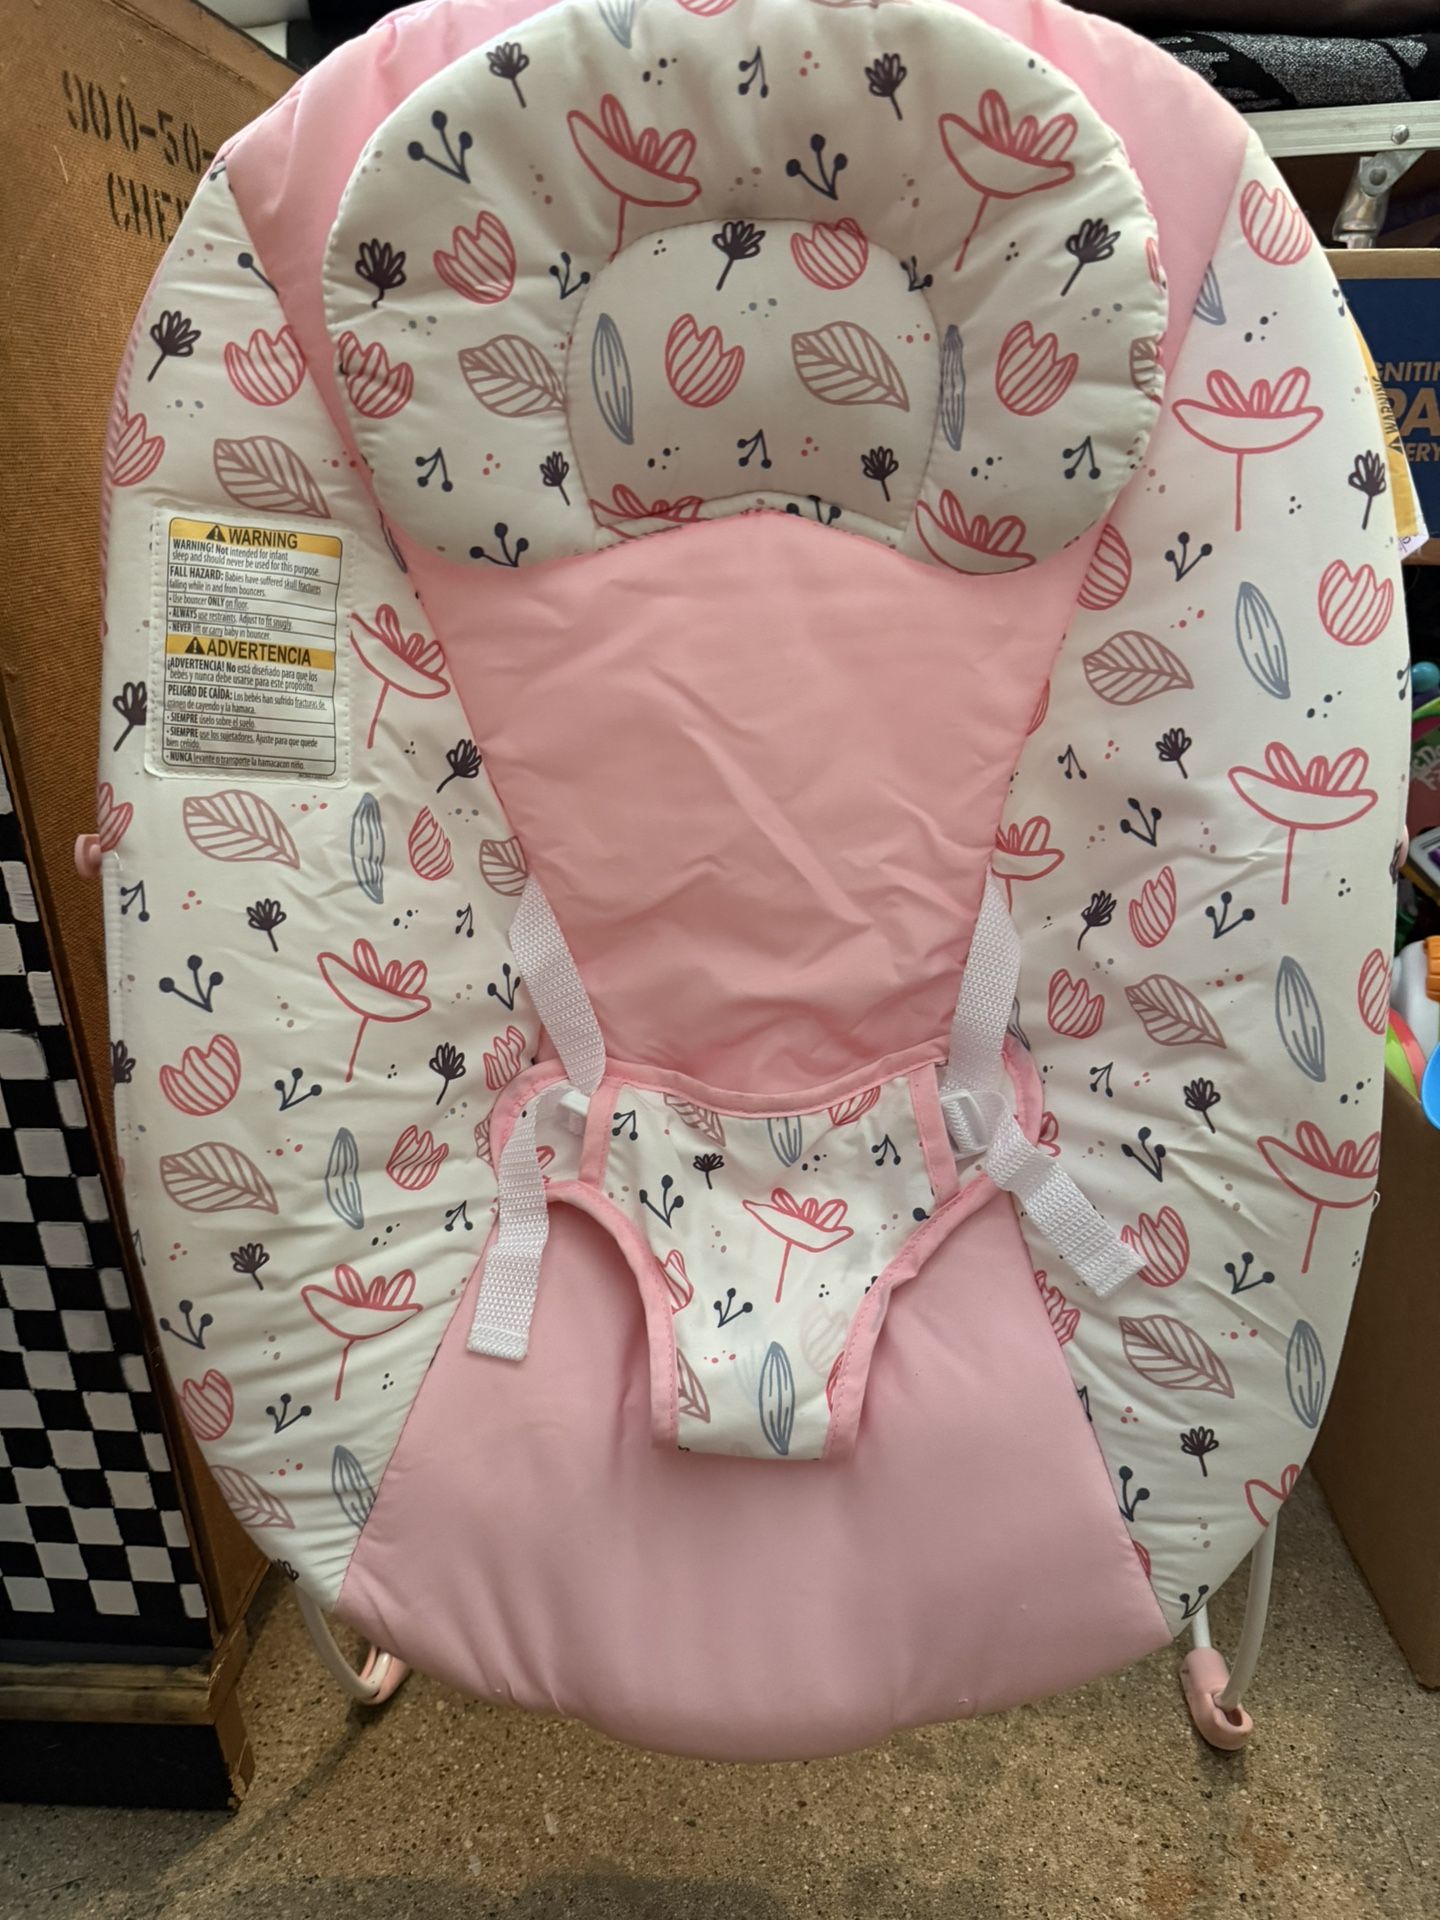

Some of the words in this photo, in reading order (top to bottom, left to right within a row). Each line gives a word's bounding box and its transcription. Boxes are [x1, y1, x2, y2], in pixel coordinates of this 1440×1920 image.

[229, 528, 298, 548] WARNING
[173, 539, 214, 553] WARNING!
[216, 545, 228, 555] Not
[230, 547, 258, 558] intended
[260, 549, 268, 559] for
[270, 550, 288, 560] infant
[172, 551, 188, 562] sleep
[190, 552, 202, 561] and
[204, 553, 224, 565] should
[226, 559, 244, 567] never
[245, 558, 253, 568] be
[255, 560, 269, 569] used
[271, 561, 279, 570] for
[281, 562, 292, 572] this
[294, 565, 320, 577] purpose.
[170, 566, 187, 577] FALL
[190, 567, 224, 580] HAZARD:
[225, 572, 244, 582] Babies
[245, 573, 259, 584] have
[260, 575, 283, 587] suffered
[189, 581, 204, 590] while
[206, 582, 211, 591] in
[212, 583, 223, 593] and
[224, 583, 238, 594] from
[239, 585, 265, 597] bouncers.
[173, 595, 183, 604] Use
[184, 595, 206, 605] bouncer
[208, 596, 224, 606] ONLY
[225, 600, 233, 608] on
[173, 608, 197, 619] ALWAYS
[198, 612, 207, 620] use
[239, 615, 257, 625] Adjust
[259, 616, 264, 625] to
[173, 622, 191, 632] NEVER
[209, 627, 222, 637] carry
[224, 627, 238, 638] baby
[240, 629, 245, 637] in
[247, 629, 271, 640] bouncer.
[207, 638, 311, 666] ADVERTENCIA
[168, 658, 224, 672] ¡ADVERTENCIA!
[226, 662, 236, 673] No
[252, 664, 280, 677] diseñado
[282, 670, 295, 680] para
[296, 671, 307, 681] que
[309, 671, 317, 682] los
[195, 672, 214, 681] nunca
[216, 672, 231, 683] debe
[233, 676, 253, 685] usarse
[255, 677, 269, 687] para
[168, 684, 196, 697] PELIGRO
[198, 686, 207, 698] DE
[209, 685, 232, 699] CAÍDA:
[234, 691, 243, 701] Los
[263, 694, 273, 703] han
[187, 699, 194, 708] de
[196, 700, 219, 711] cayendo
[226, 702, 231, 712] la
[171, 712, 198, 723] SIEMPRE
[216, 715, 232, 726] sobre
[170, 727, 198, 738] SIEMPRE
[211, 731, 219, 740] los
[256, 735, 273, 746] Ajuste
[275, 737, 287, 747] para
[289, 738, 300, 747] que
[301, 737, 317, 748] quede
[170, 752, 192, 762] NUNCA
[251, 756, 256, 765] la
